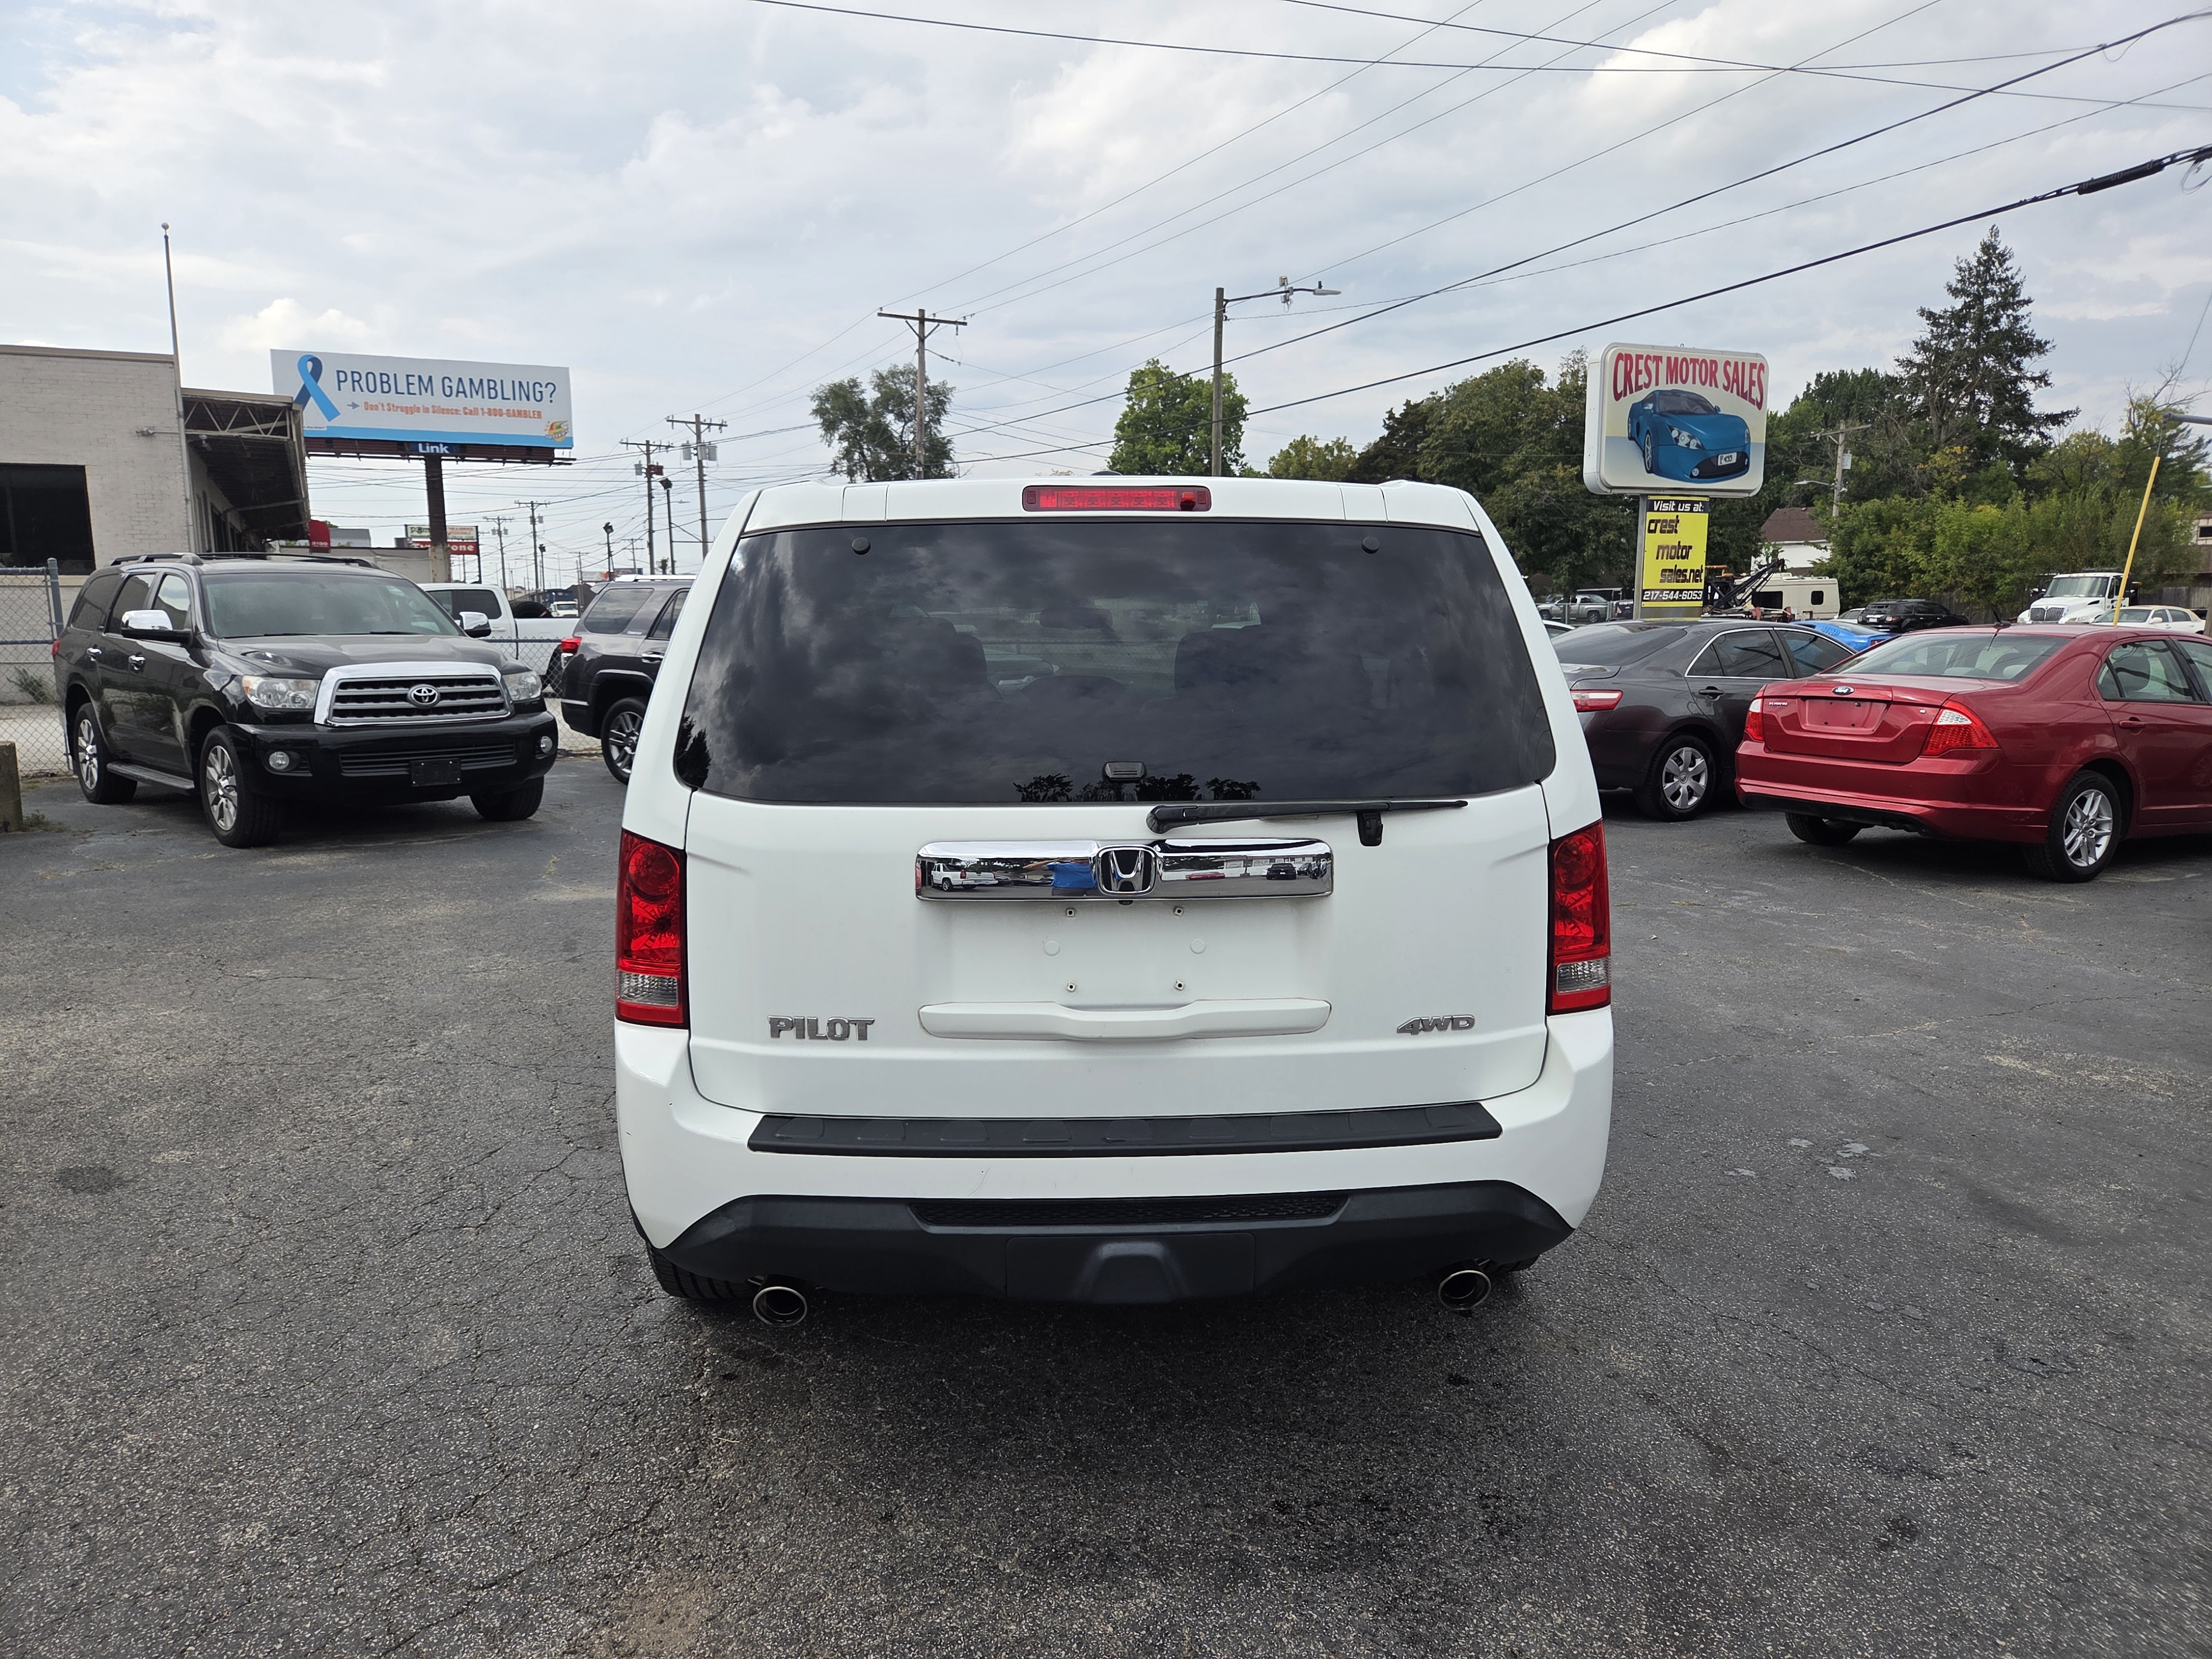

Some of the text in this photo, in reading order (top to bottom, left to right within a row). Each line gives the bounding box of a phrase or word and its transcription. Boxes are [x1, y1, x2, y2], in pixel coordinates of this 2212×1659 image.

[336, 370, 556, 403] PROBLEM GAMBLING?
[1613, 352, 1765, 410] CREST MOTOR SALES
[364, 401, 384, 411] Don't
[387, 402, 420, 415] Struggle
[422, 404, 430, 413] in
[462, 406, 479, 416] Call
[480, 407, 542, 419] 1-800-GAMBLER
[418, 443, 450, 453] Link
[1653, 500, 1704, 512] Visit us at:
[1647, 515, 1679, 534] crest
[1656, 541, 1693, 560] motor
[1660, 564, 1703, 583] sales.net
[1643, 591, 1703, 600] 217-544-6053
[768, 1015, 875, 1041] PILOT
[1396, 1014, 1475, 1035] 4WD
